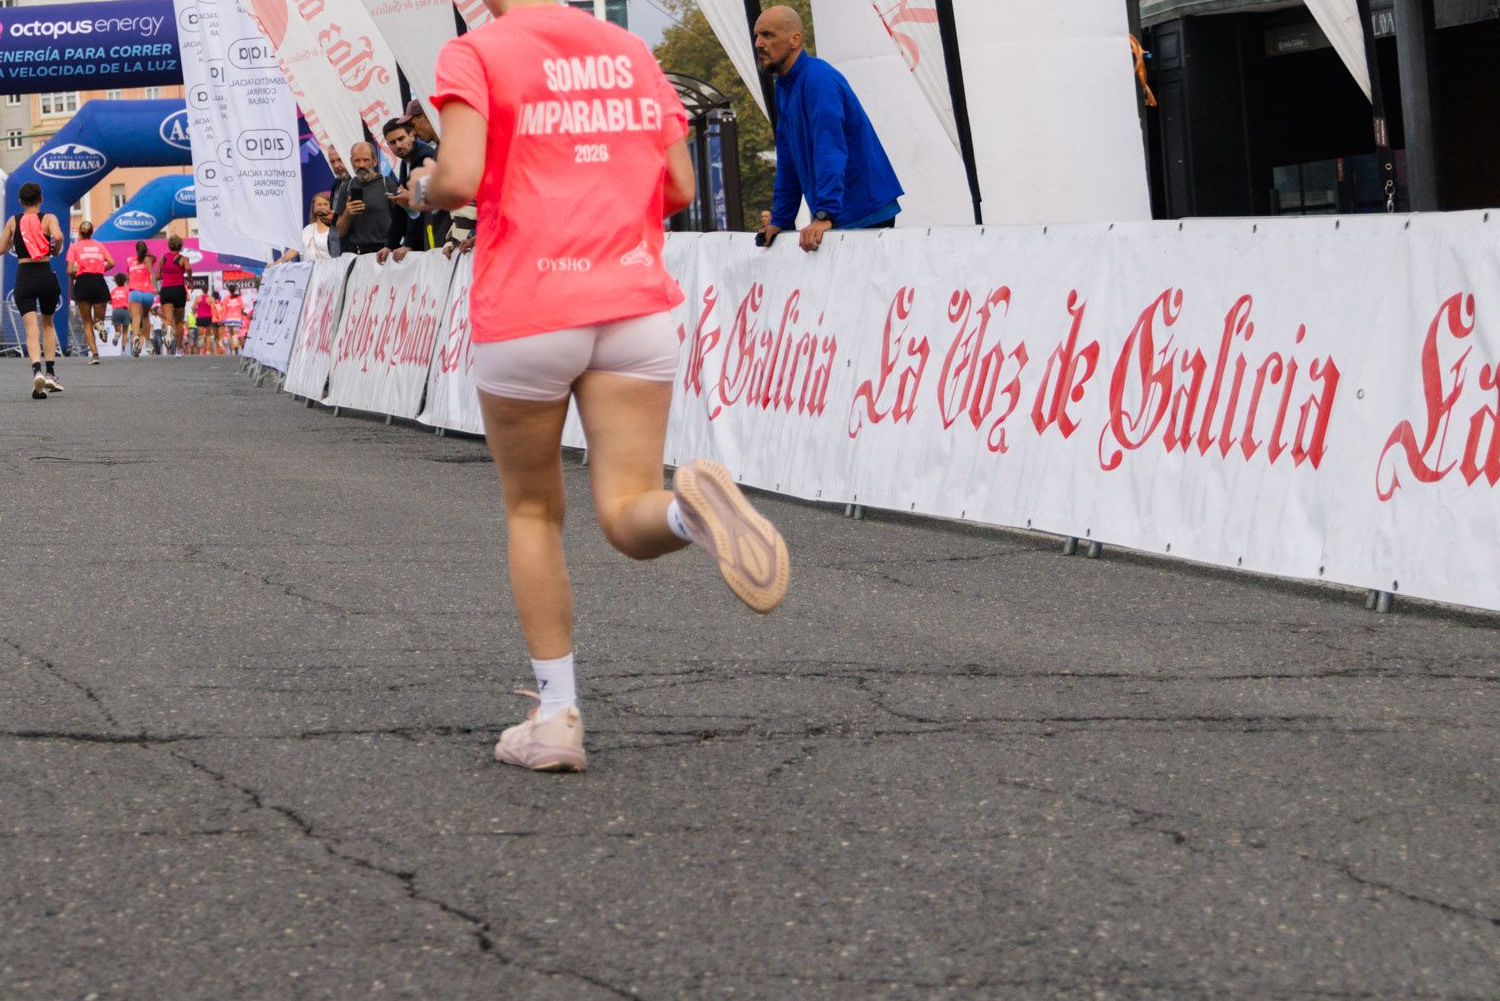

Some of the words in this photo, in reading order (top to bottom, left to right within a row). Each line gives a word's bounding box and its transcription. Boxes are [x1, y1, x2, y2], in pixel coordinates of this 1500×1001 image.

[10, 18, 92, 39] octopus
[94, 15, 164, 37] energy
[64, 47, 106, 61] PARA
[110, 43, 171, 58] CORRER
[8, 63, 95, 78] VELOCIDAD
[99, 62, 119, 74] DE
[123, 61, 142, 73] LA
[147, 59, 177, 72] LUZ
[543, 55, 635, 92] SOMOS
[38, 157, 100, 170] ASTURIANA
[574, 144, 609, 163] 2026
[538, 257, 591, 272] OYSHO
[707, 281, 838, 422] Galicia
[848, 286, 931, 440] La
[937, 284, 1029, 454] Voz
[1030, 288, 1101, 440] de
[1098, 286, 1341, 472] Galicia
[1375, 291, 1500, 502] La
